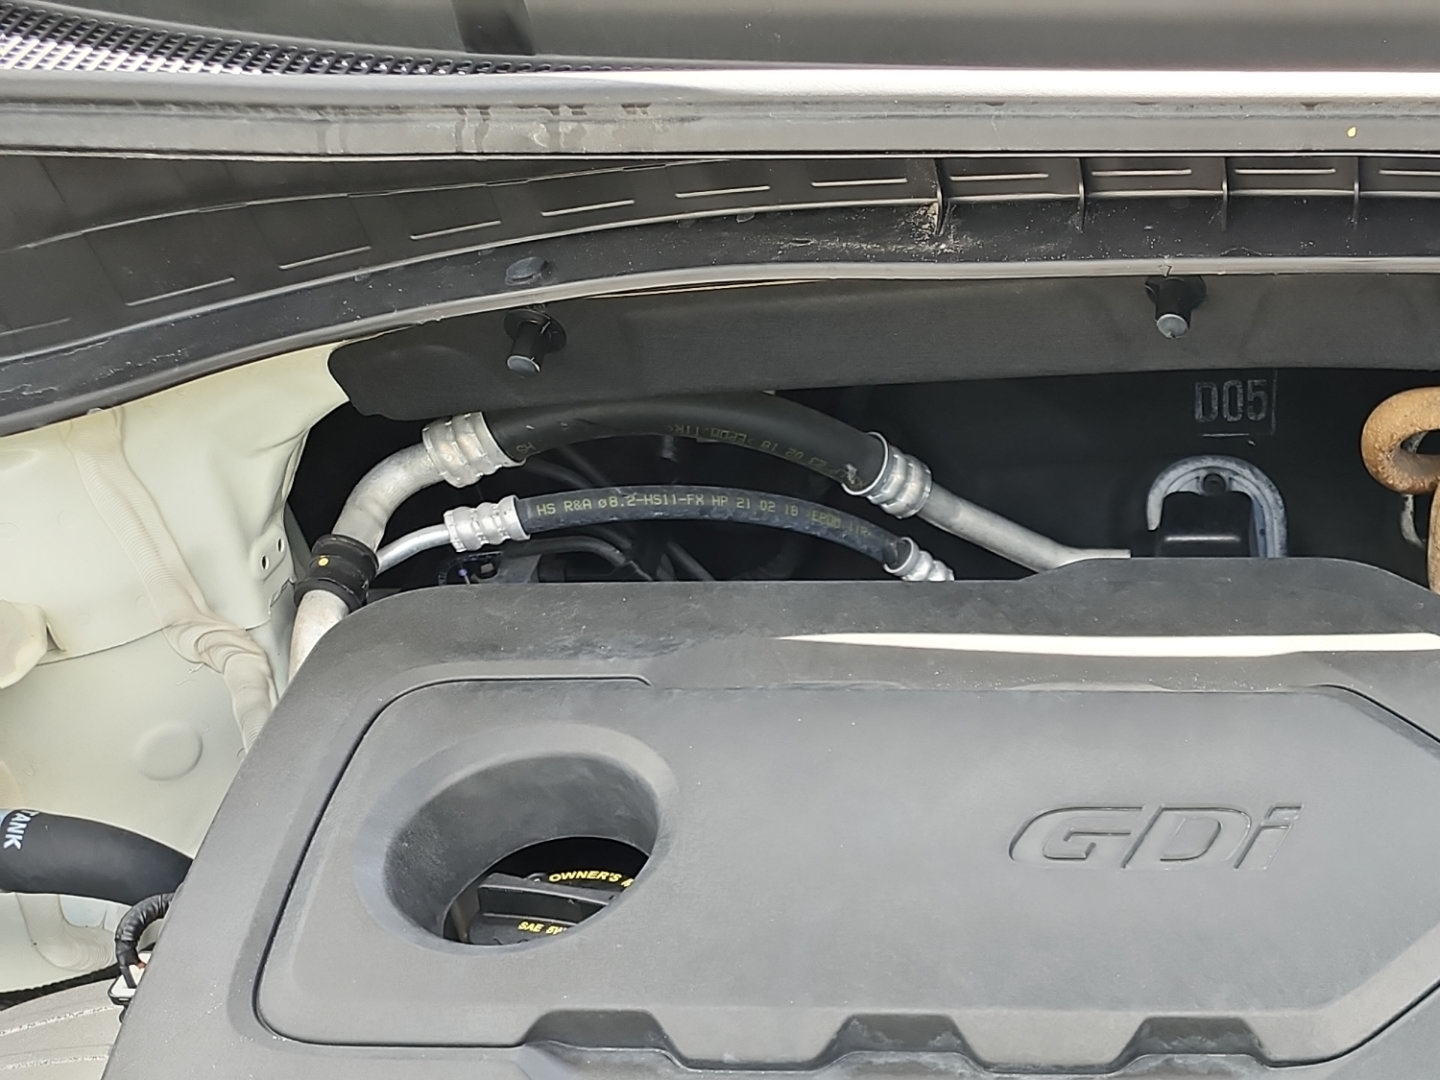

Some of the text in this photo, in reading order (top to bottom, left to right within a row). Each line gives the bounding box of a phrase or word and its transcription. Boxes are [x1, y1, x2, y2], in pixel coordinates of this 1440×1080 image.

[1194, 379, 1268, 422] D05
[536, 503, 556, 516] HS
[563, 498, 592, 512] R&A
[711, 494, 728, 507] HP
[736, 496, 750, 509] 21
[760, 499, 776, 513] 02
[1007, 803, 1304, 870] GDi
[548, 870, 622, 882] OWNER'S
[518, 922, 544, 932] SAE
